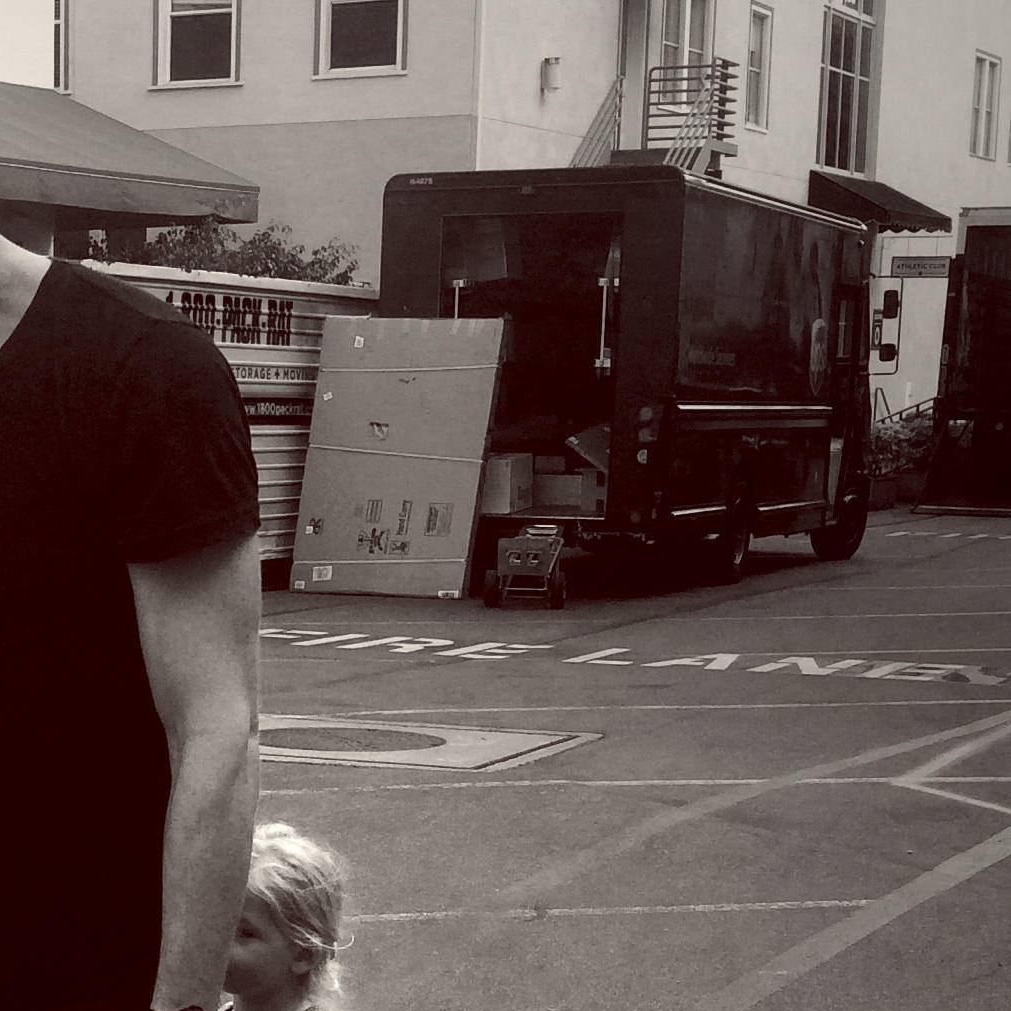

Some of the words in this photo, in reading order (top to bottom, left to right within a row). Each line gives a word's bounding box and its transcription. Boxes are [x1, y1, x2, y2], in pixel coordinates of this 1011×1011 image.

[165, 290, 294, 346] 800-PACK-RAT
[231, 366, 272, 381] TORAGE
[258, 628, 555, 660] FIRE
